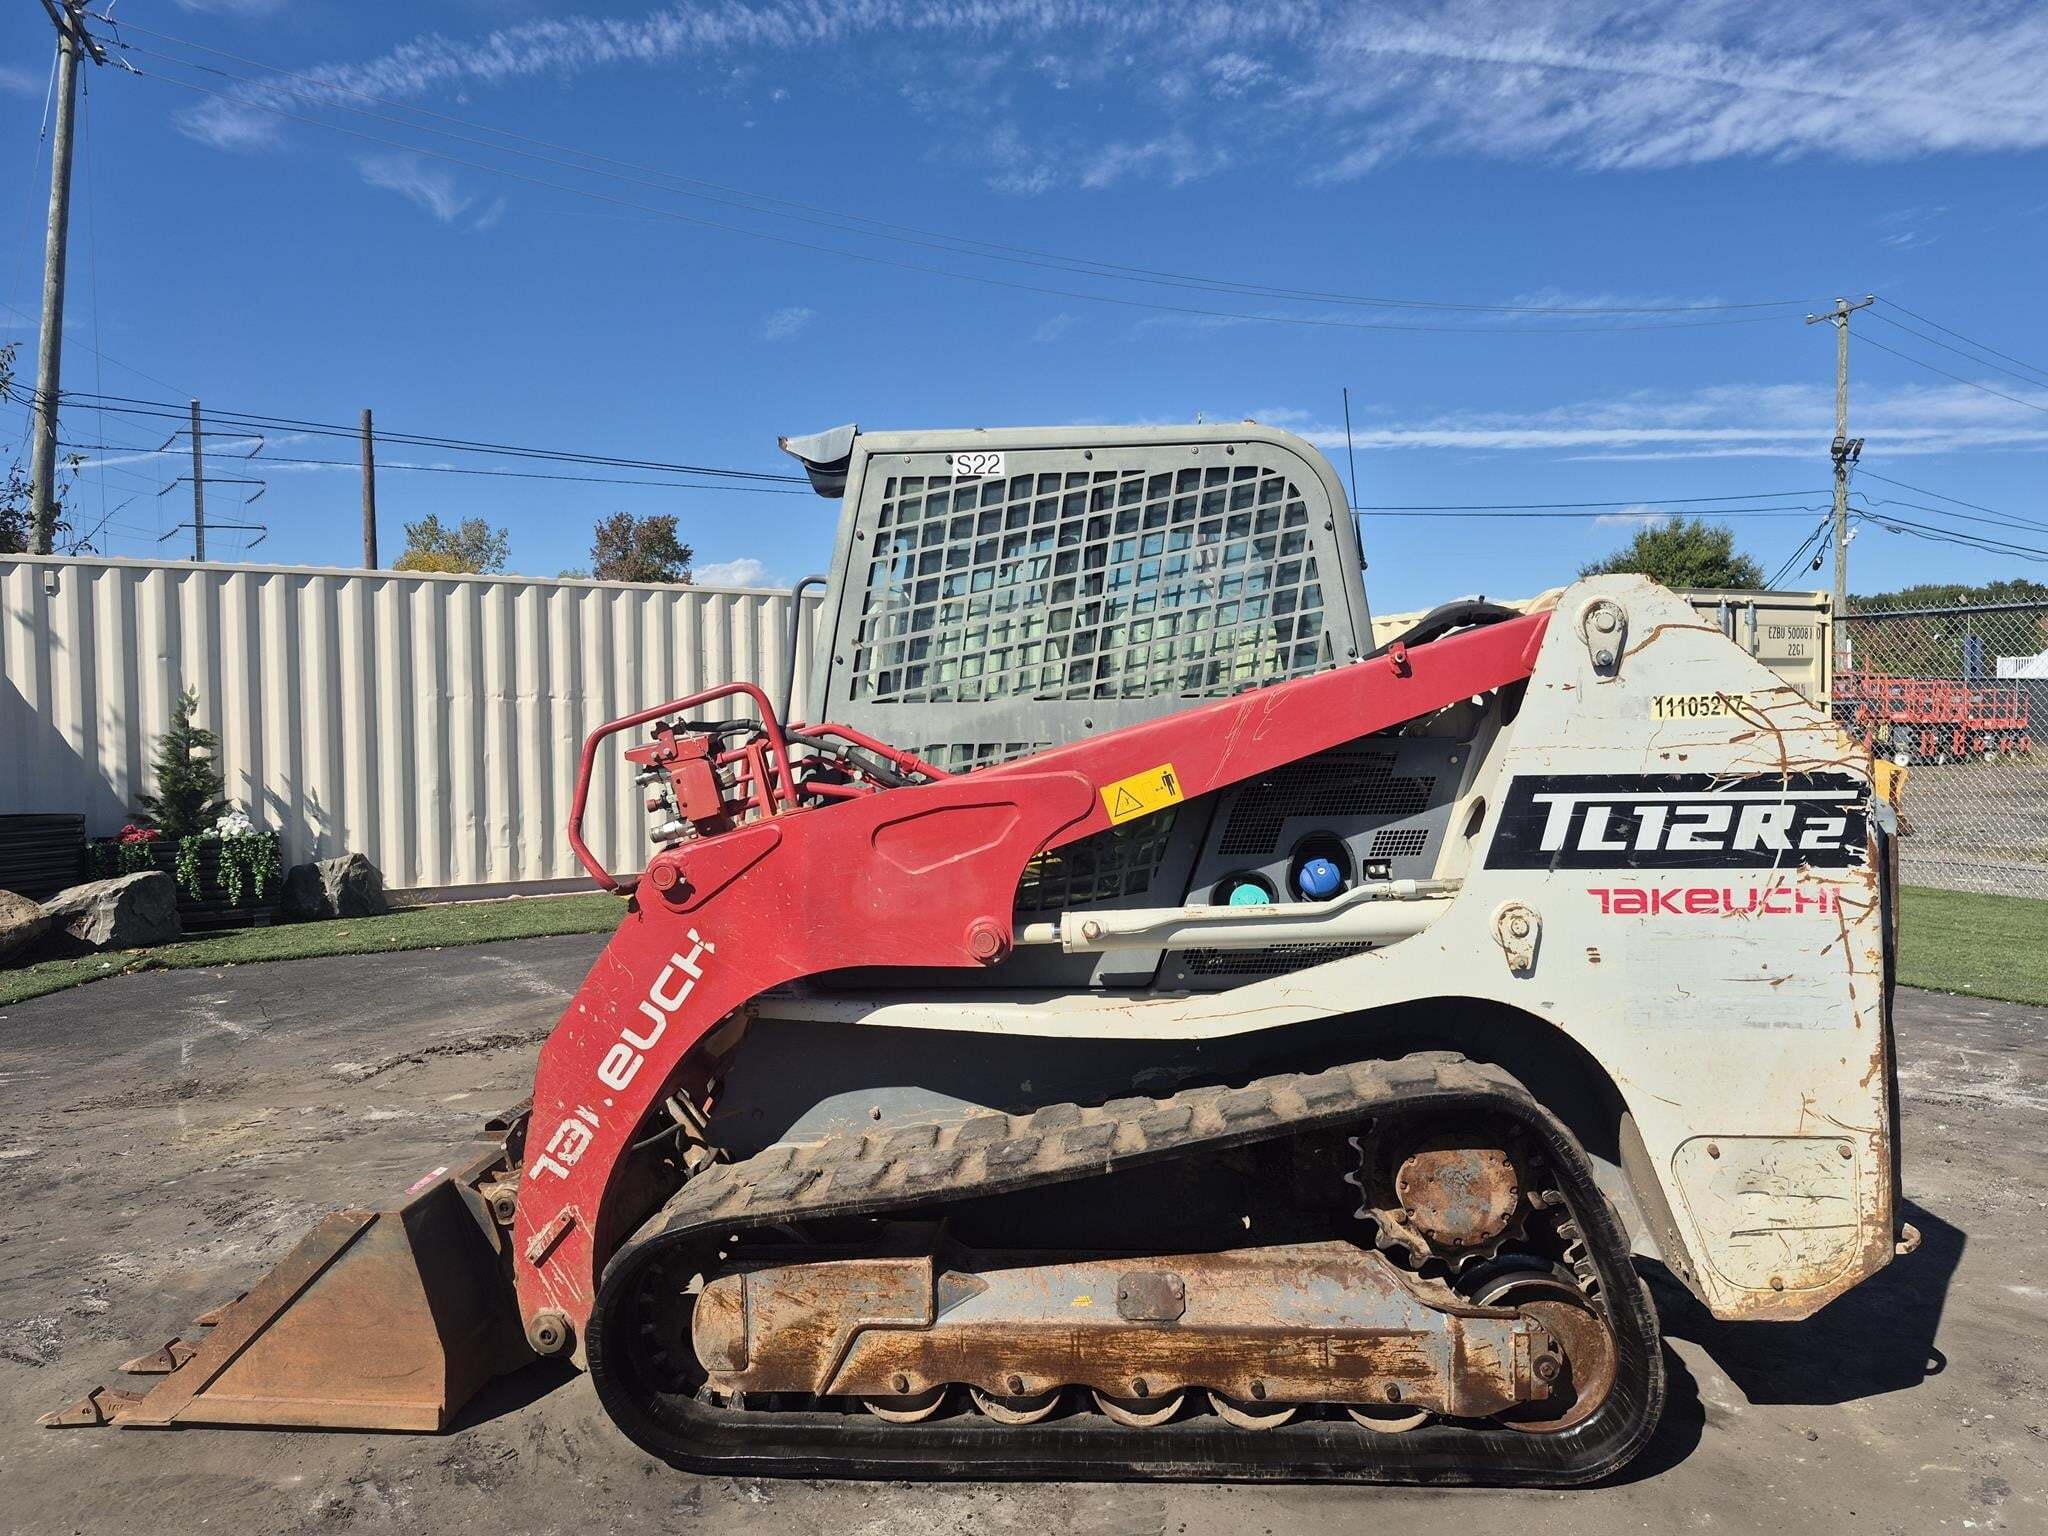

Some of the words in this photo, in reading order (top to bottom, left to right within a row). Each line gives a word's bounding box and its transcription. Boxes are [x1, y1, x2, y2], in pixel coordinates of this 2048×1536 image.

[956, 453, 1001, 475] S22
[1768, 626, 1786, 639] EZBU
[1532, 789, 1859, 851] TL12R2
